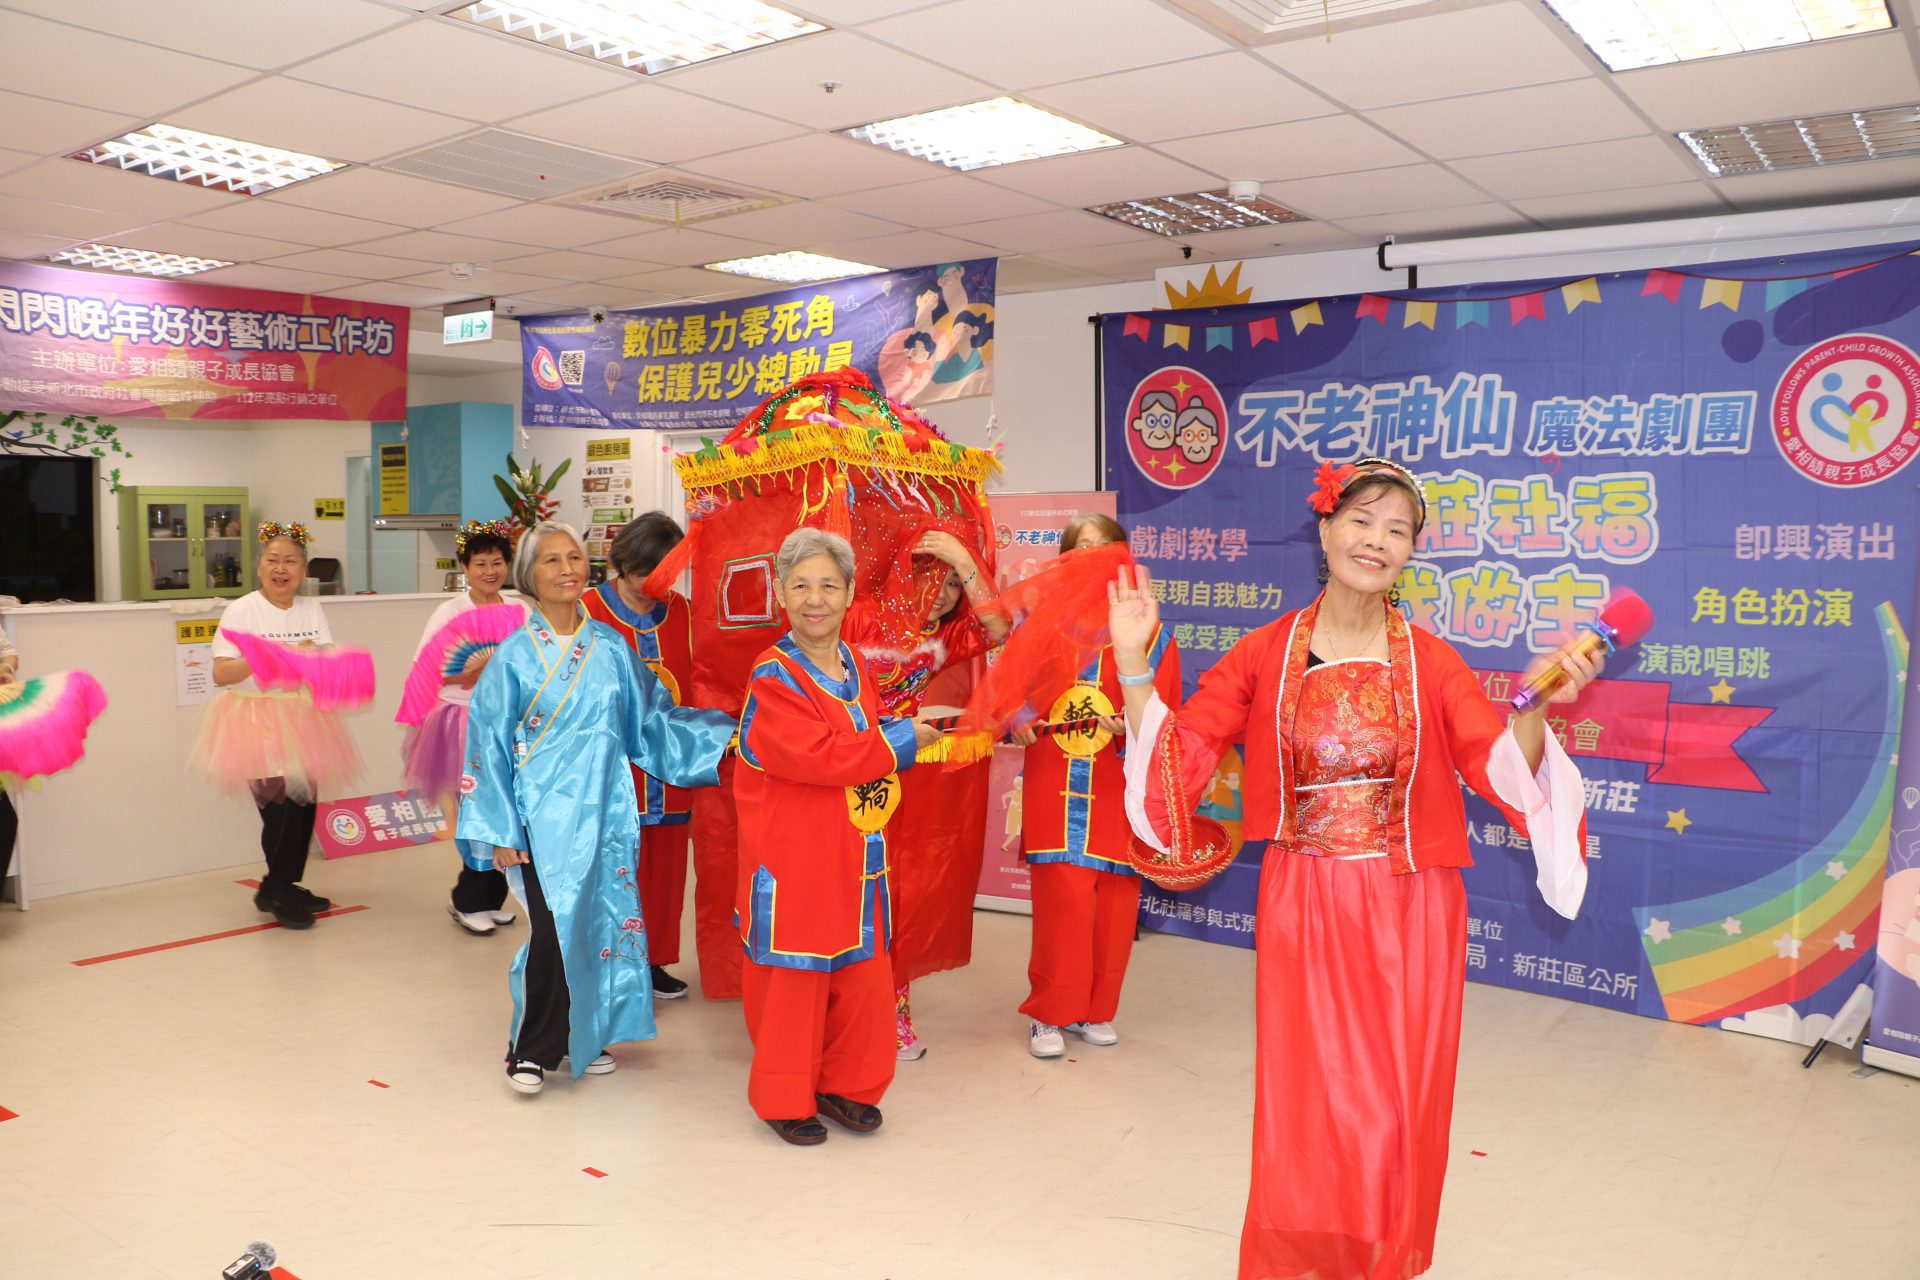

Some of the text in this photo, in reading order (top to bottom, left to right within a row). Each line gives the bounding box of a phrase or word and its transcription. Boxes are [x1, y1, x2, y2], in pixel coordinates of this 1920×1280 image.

[623, 294, 836, 358] 數位暴力零死角
[638, 340, 853, 403] 保護兒少總動員
[1806, 342, 1866, 369] PARENT-CHILD
[1867, 344, 1906, 367] GROWTH
[1782, 368, 1807, 403] FOLLOWS
[1234, 372, 1757, 467] 不老神仙 魔法劇團
[1780, 405, 1790, 426] LOVE
[1783, 430, 1919, 481] 愛相隨親子成長協會
[1130, 522, 1895, 562] 戲劇教學 即興演出
[1149, 578, 1854, 627] 展現自我魅力 角色扮演
[261, 629, 319, 639] EQUIPMENT
[1173, 623, 1772, 679] 感受表 演說唱跳
[1583, 777, 1640, 814] 新莊
[1138, 893, 1256, 933] 北社福參與式預
[1467, 916, 1504, 942] 單位
